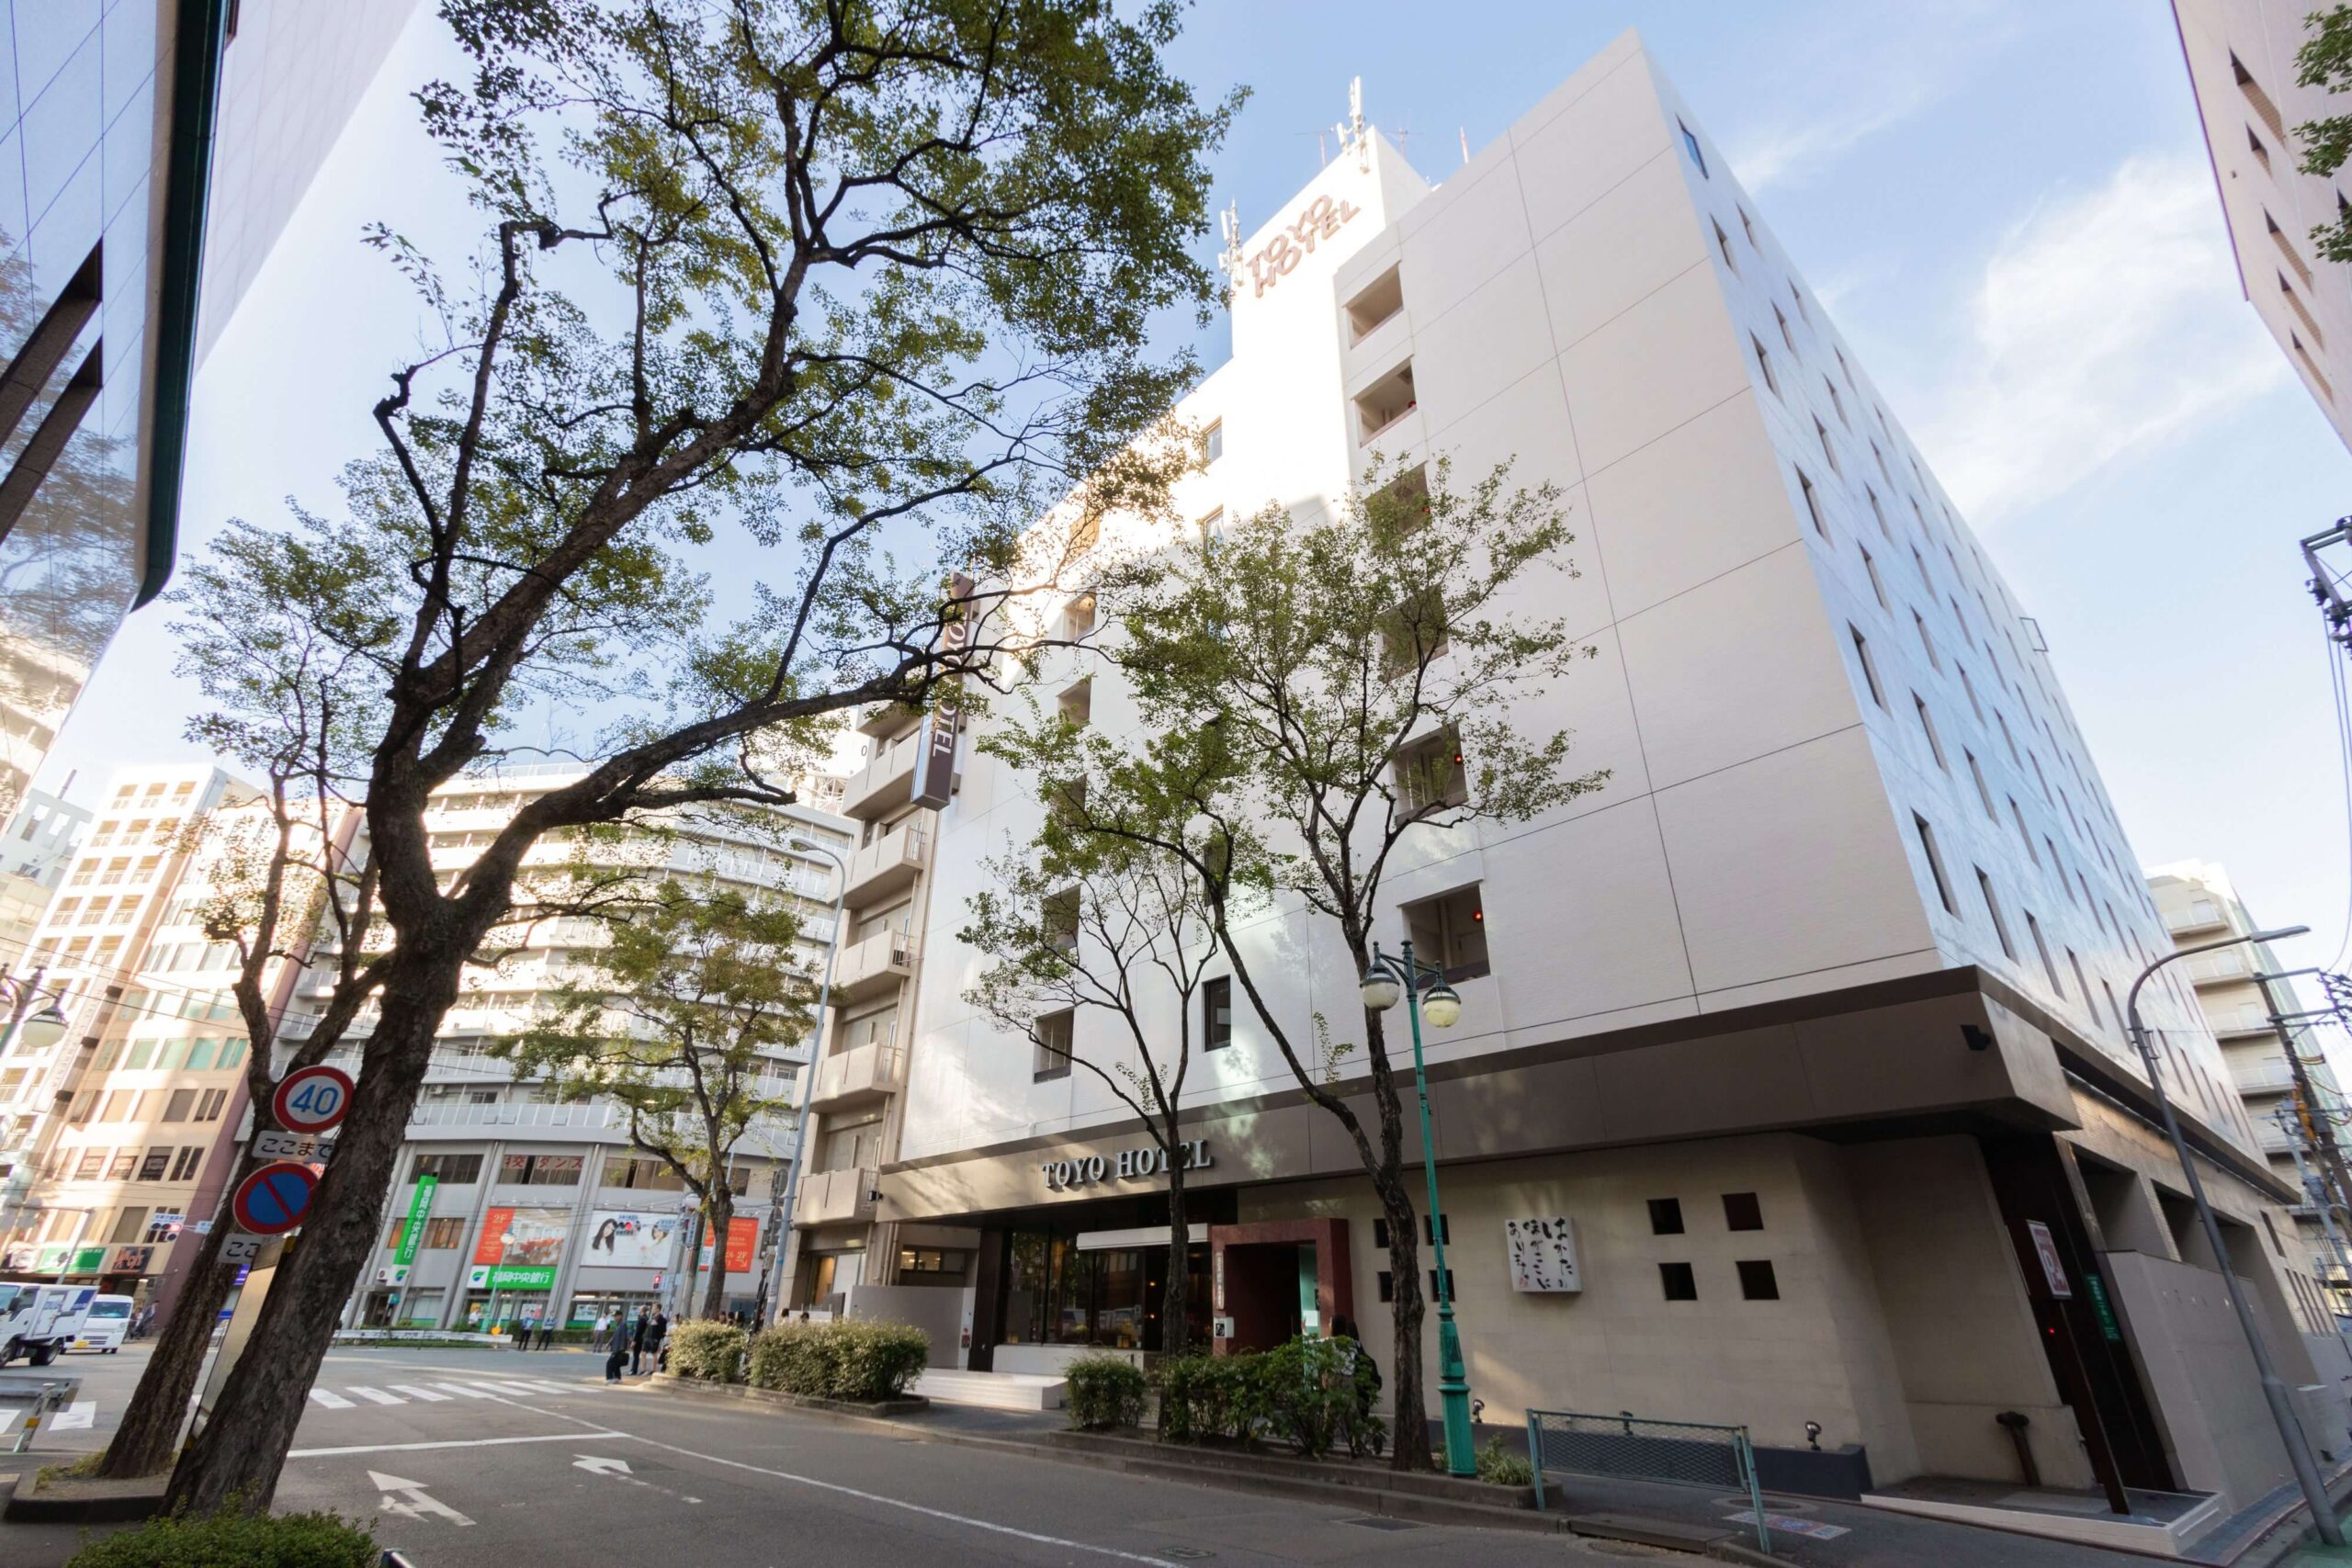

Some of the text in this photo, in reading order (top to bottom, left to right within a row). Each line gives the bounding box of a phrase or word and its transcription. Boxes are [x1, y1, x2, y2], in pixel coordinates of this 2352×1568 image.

[1246, 195, 1333, 276] TOYO
[1253, 199, 1362, 299] HOTEL
[290, 1084, 339, 1115] 40
[1042, 1155, 1105, 1188] TOYO
[492, 1271, 550, 1284] 福岡中央銀行
